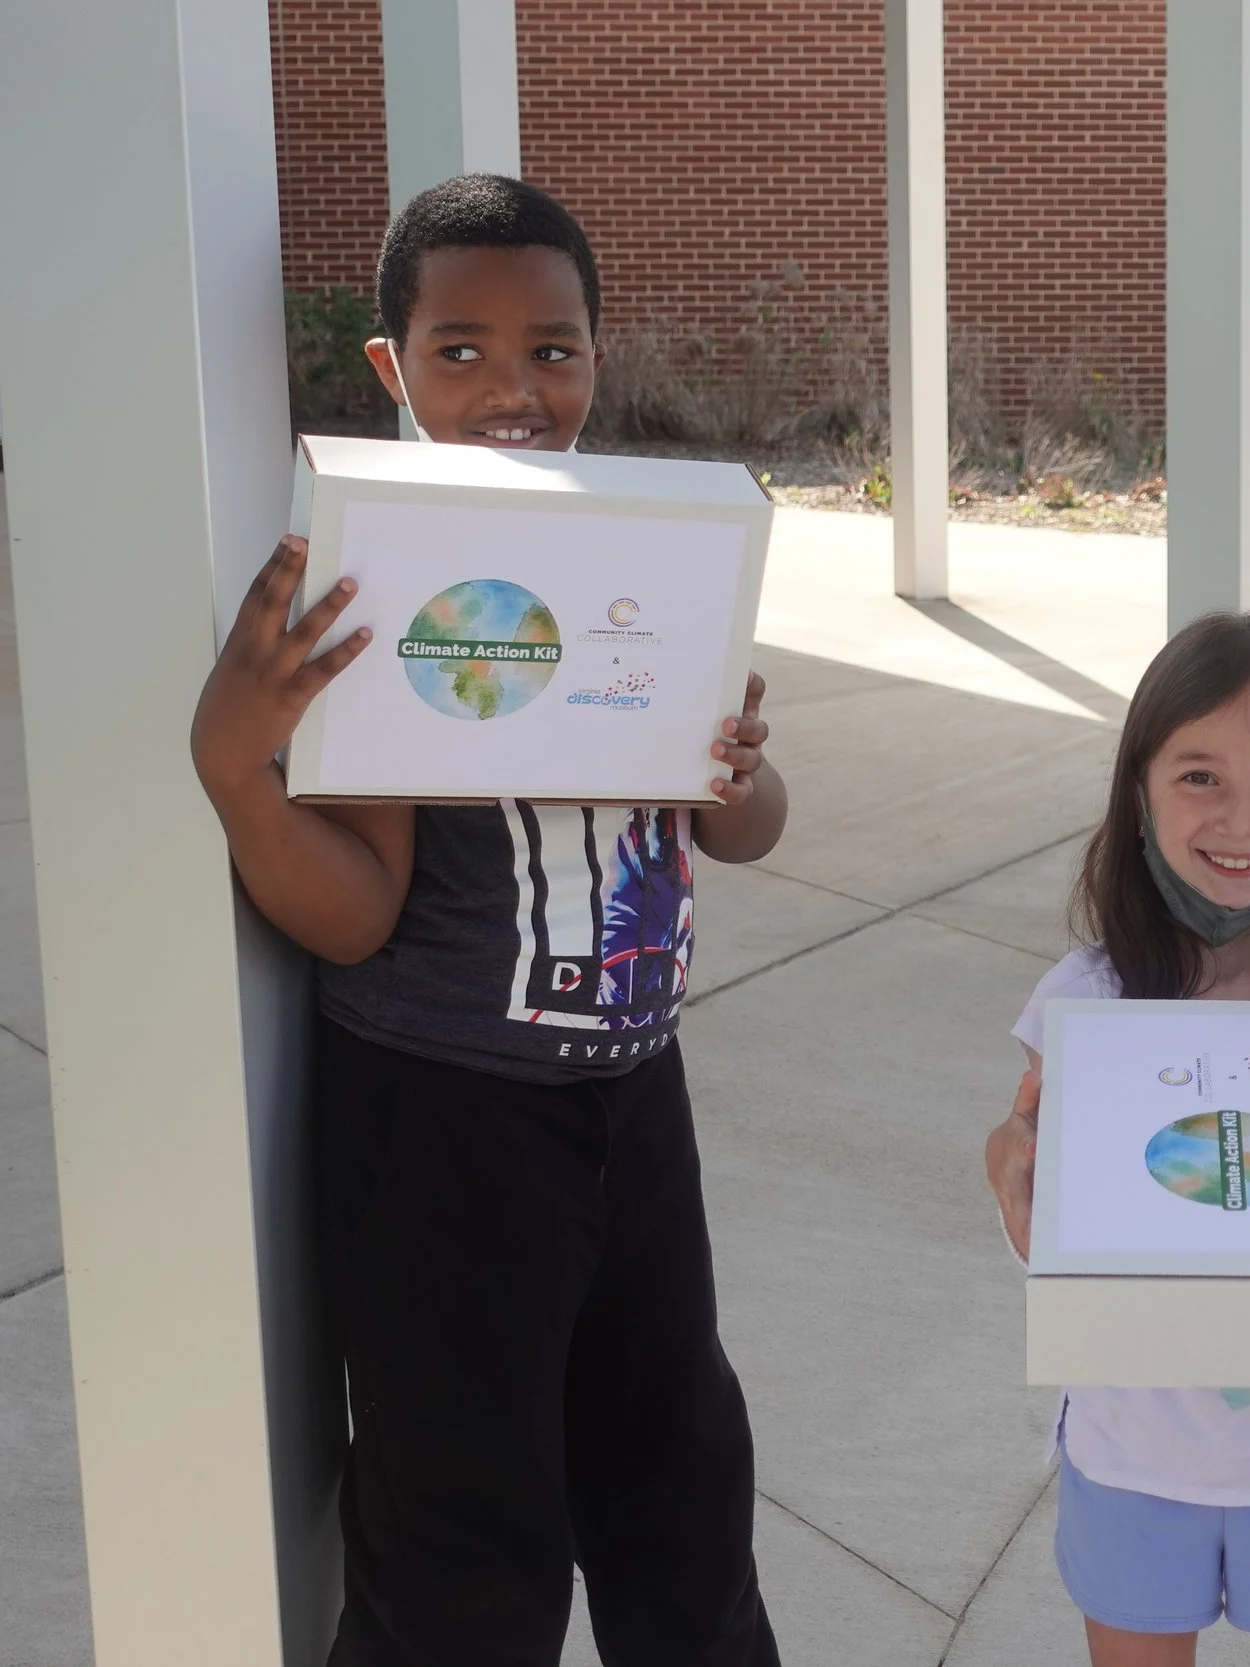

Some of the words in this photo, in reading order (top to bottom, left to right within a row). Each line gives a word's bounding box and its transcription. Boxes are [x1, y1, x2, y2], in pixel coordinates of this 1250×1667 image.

[576, 635, 663, 645] COLLABORATIVE
[401, 641, 471, 657] Climate
[473, 644, 530, 659] Action
[534, 646, 559, 660] Kit
[567, 692, 651, 709] discovery
[558, 1028, 677, 1058] EVERYD
[1221, 1112, 1237, 1128] Kit
[1223, 1129, 1240, 1163] Action
[1225, 1163, 1243, 1209] Climate
